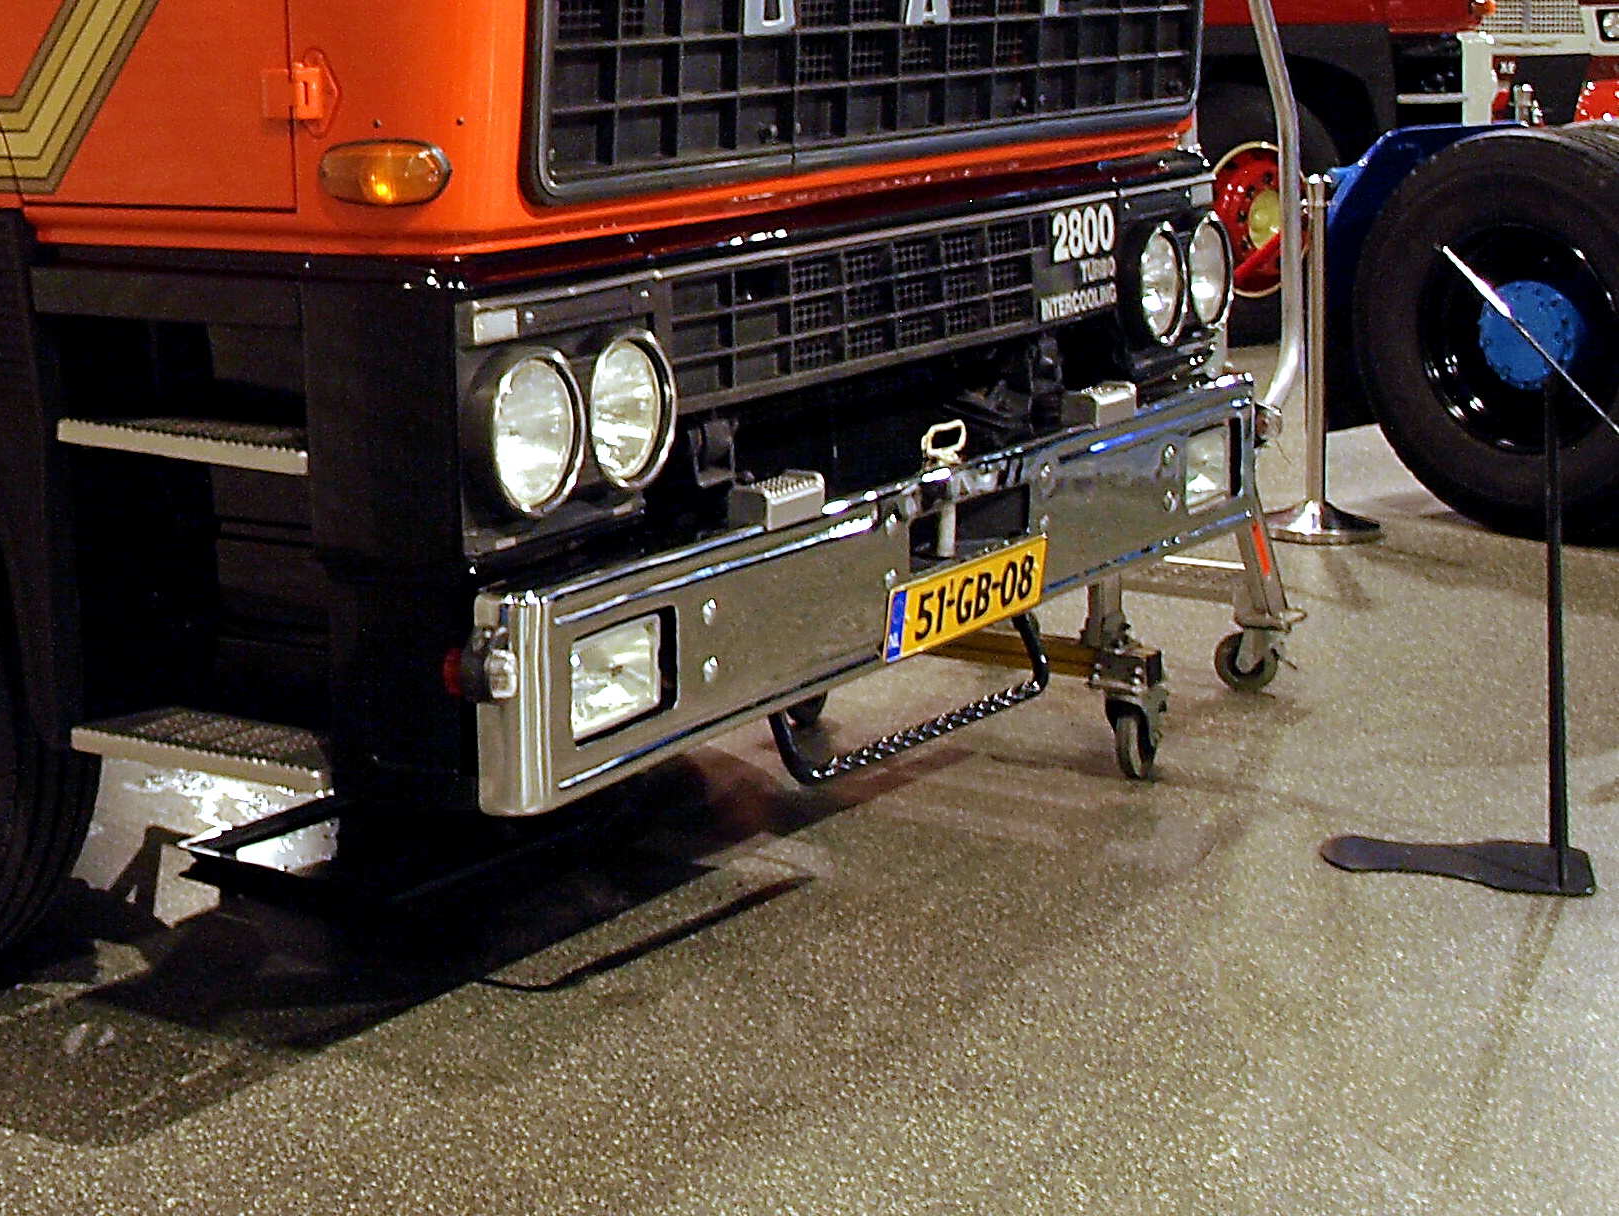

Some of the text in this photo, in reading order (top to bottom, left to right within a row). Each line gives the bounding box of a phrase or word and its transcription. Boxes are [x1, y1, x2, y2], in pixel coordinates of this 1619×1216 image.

[1052, 203, 1116, 263] 2800
[1040, 282, 1118, 323] INTERCOOLING
[914, 554, 1035, 642] 51-GB-08
